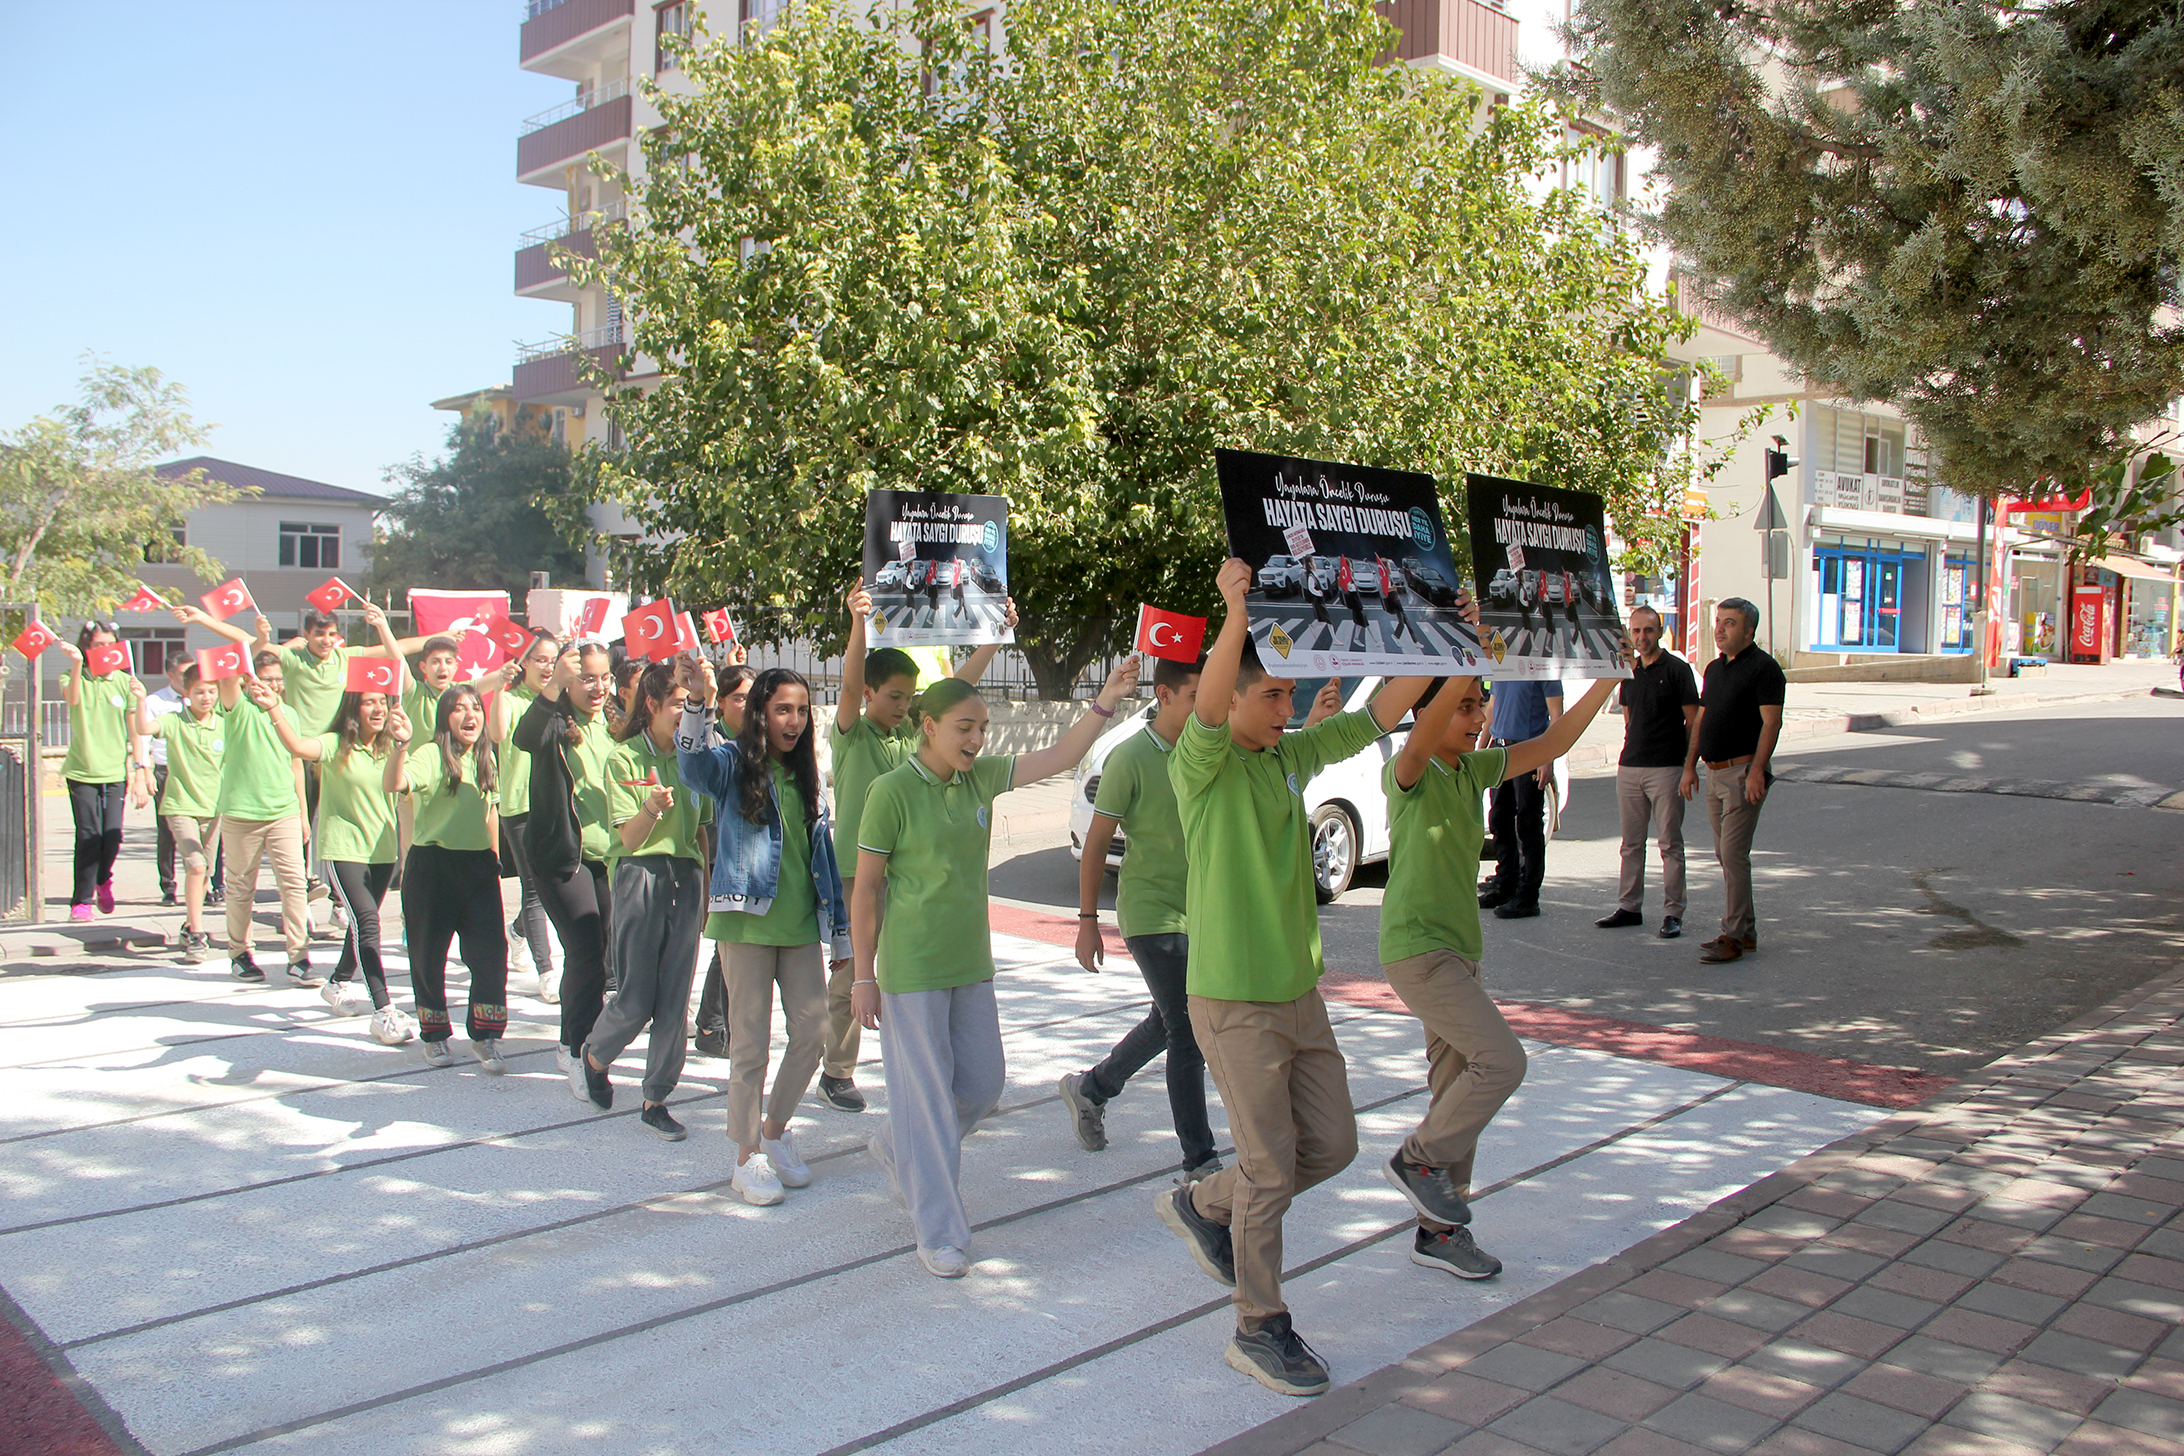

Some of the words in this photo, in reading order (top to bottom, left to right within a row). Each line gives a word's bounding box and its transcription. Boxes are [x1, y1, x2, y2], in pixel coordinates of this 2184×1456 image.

[1275, 472, 1319, 500] Yayalara
[1319, 474, 1354, 501] Öncelik
[1354, 482, 1390, 506] Duruşu
[1837, 476, 1861, 493] AVUKAT
[1262, 498, 1318, 530] HAYATA
[1315, 503, 1358, 534] SAYGI
[1356, 508, 1413, 540] DURUŞU
[1412, 522, 1430, 534] DAHA
[2033, 518, 2060, 532] DÖNER
[890, 521, 922, 542] HAYATA
[924, 522, 948, 543] SAYGI
[950, 524, 984, 546] DURUŞU
[1494, 518, 1528, 546] HAYATA
[1526, 522, 1553, 550] SAYGI
[1552, 525, 1587, 554] DURUŞU
